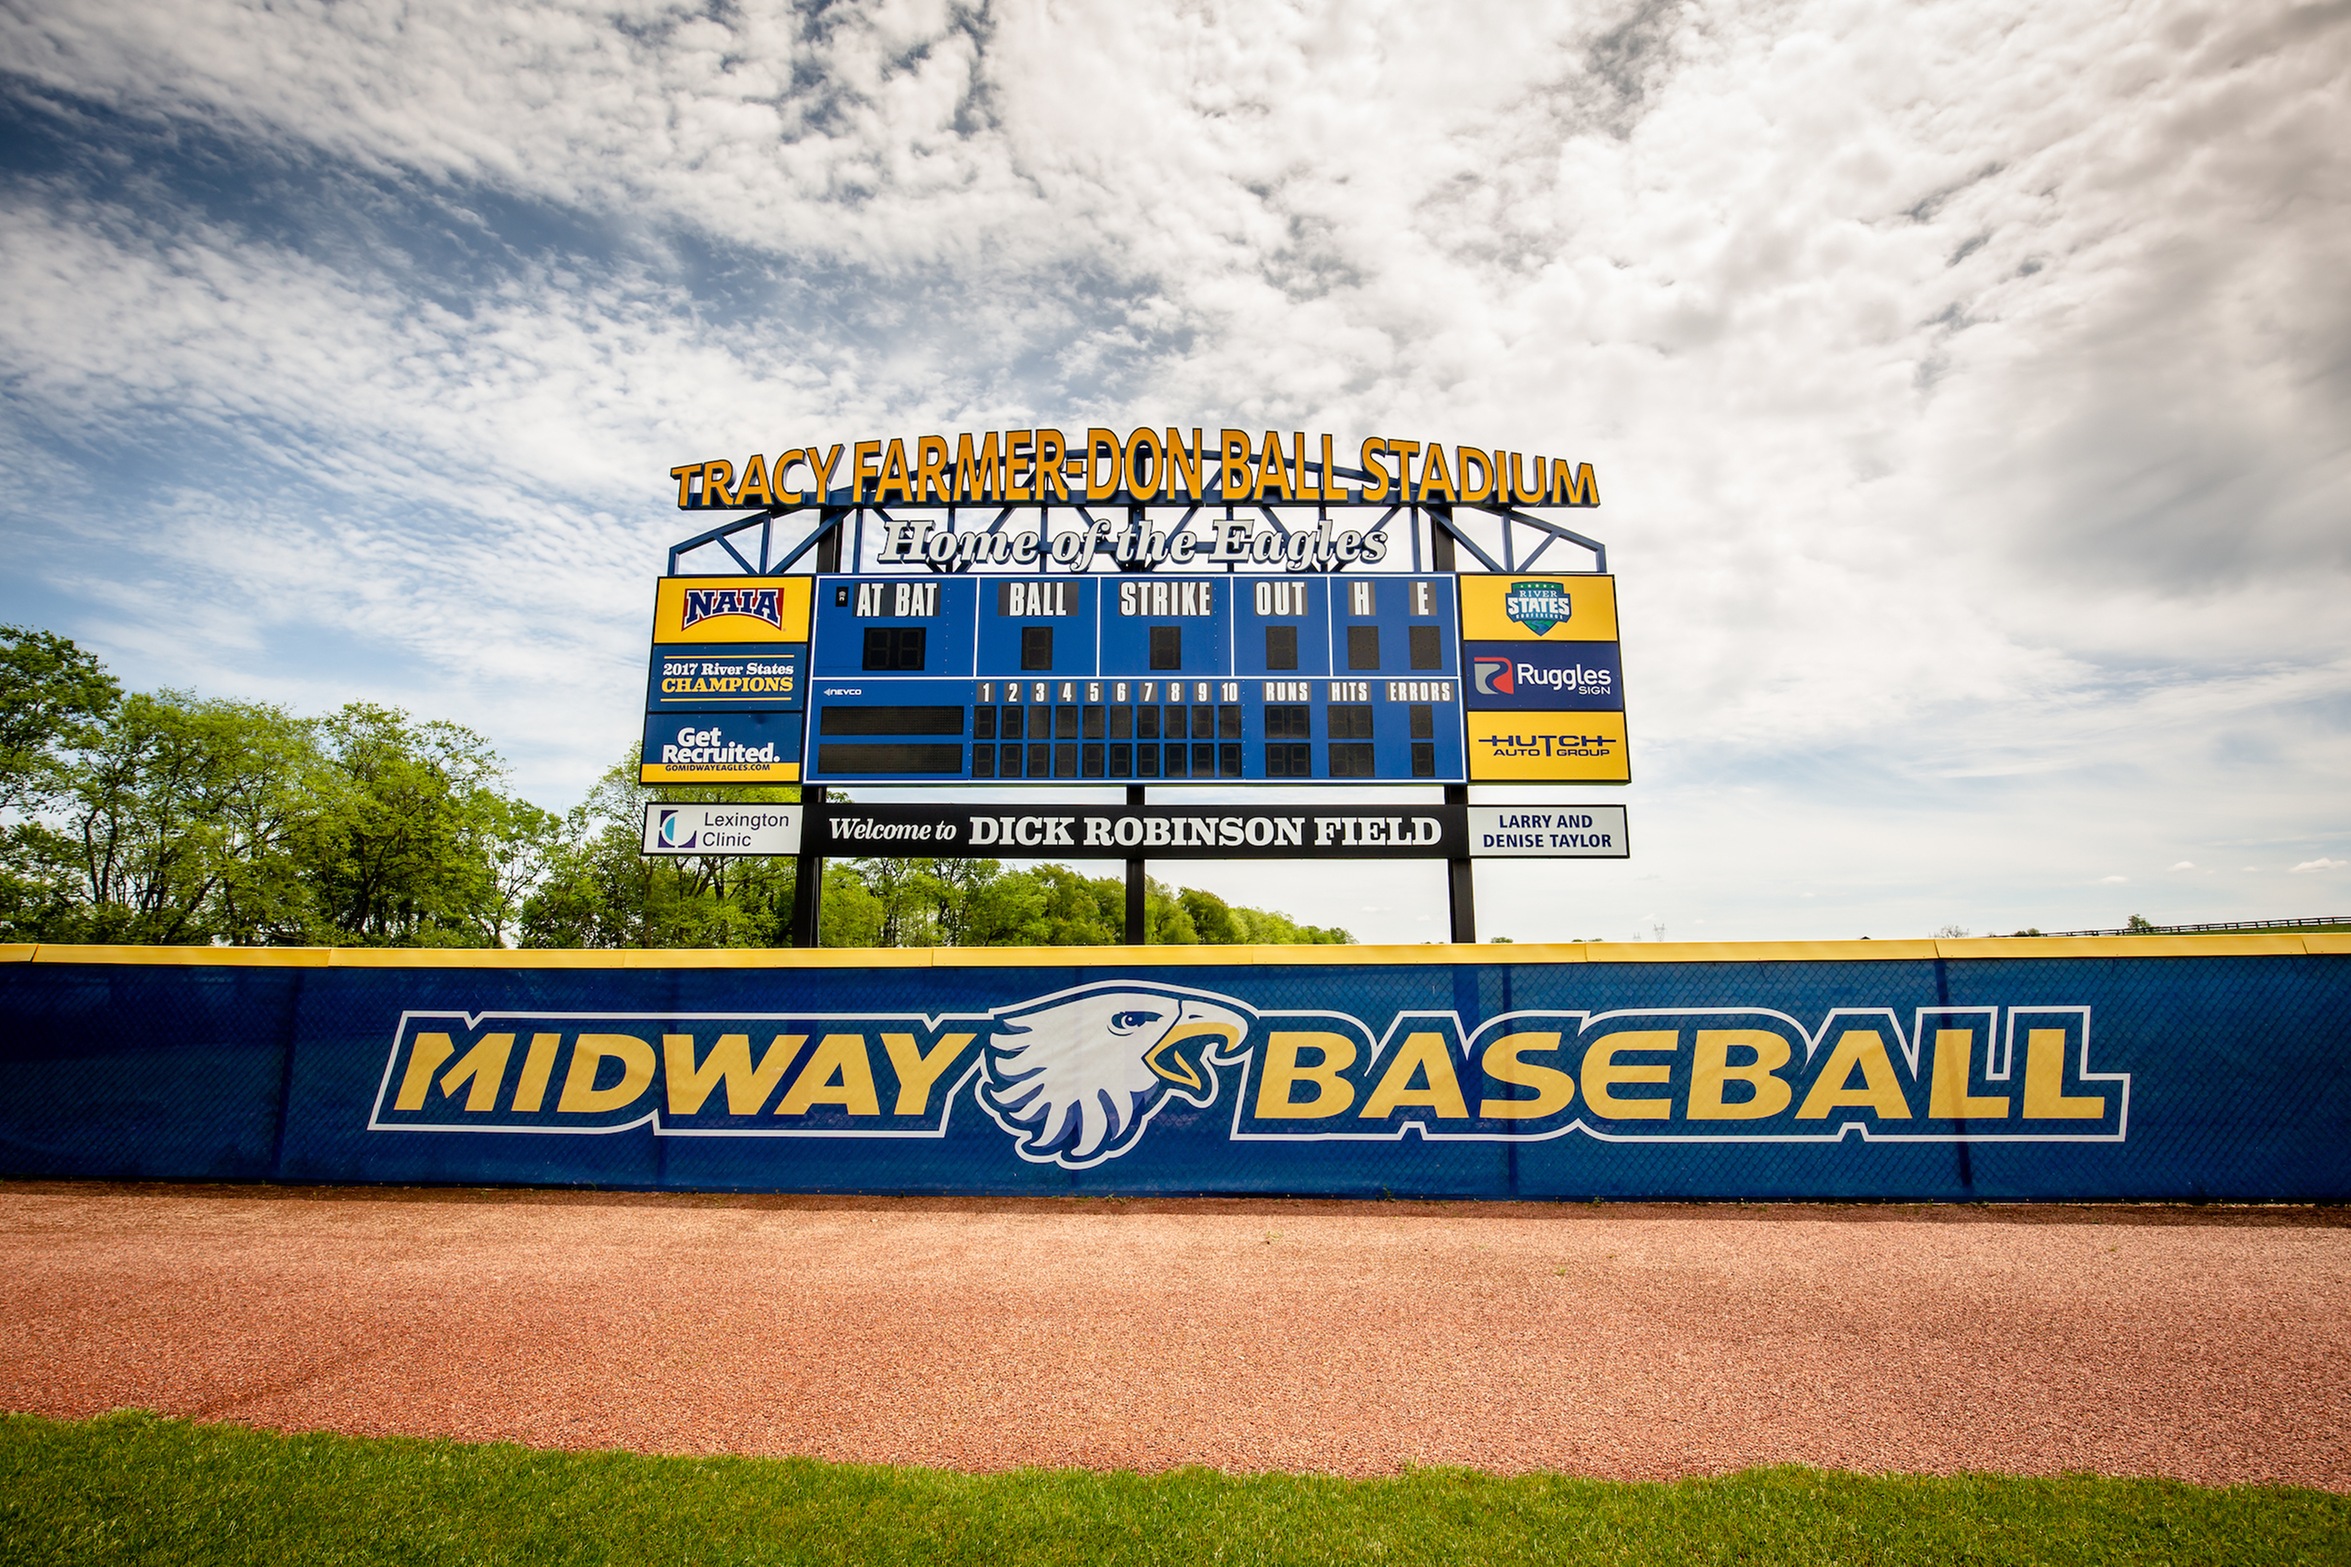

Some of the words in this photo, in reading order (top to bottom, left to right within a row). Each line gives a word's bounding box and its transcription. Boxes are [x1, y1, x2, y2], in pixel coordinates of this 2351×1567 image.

[671, 444, 845, 508] TRACY
[853, 427, 1203, 502] FARMER-DON
[1221, 429, 1348, 501] BALL
[1361, 436, 1601, 506] STADIUM
[878, 520, 1039, 564] Home
[1052, 519, 1111, 573] of
[1116, 519, 1197, 564] the
[1208, 519, 1388, 572] Eagles
[856, 583, 884, 617] AT
[895, 583, 937, 617] BAT
[1009, 582, 1067, 616] BALL
[1120, 581, 1211, 616] STRIKE
[1256, 581, 1305, 616] OUT
[1354, 582, 1370, 616] H
[1417, 582, 1429, 616] E
[1519, 590, 1558, 598] RIVER
[682, 589, 782, 630] NAIA
[1507, 597, 1570, 616] STATES
[662, 663, 698, 676] 2017
[701, 662, 743, 676] River
[746, 662, 794, 675] States
[1517, 663, 1611, 690] Ruggles
[661, 676, 793, 693] CHAMPIONS
[983, 683, 990, 702] 1
[1008, 683, 1018, 702] 2
[1035, 683, 1045, 702] 3
[1062, 683, 1072, 702] 4
[1090, 683, 1099, 702] 5
[1116, 682, 1126, 702] 6
[1144, 682, 1153, 702] 7
[1171, 682, 1180, 702] 8
[1198, 682, 1207, 702] 9
[1222, 682, 1238, 702] 10
[1266, 682, 1309, 702] RUNS
[1331, 682, 1368, 702] HITS
[1390, 682, 1450, 702] ERRORS
[1578, 686, 1611, 695] SIGN
[677, 727, 721, 747] Get
[1479, 735, 1616, 757] HUTCH
[662, 741, 781, 763] Recruited.
[1493, 748, 1541, 757] AUTO
[1556, 748, 1610, 757] GROUP
[665, 763, 770, 772] GOMIDWAYEAGLES.COM
[704, 812, 789, 831] Lexington
[828, 818, 932, 840] Welcome
[935, 820, 957, 841] to
[968, 816, 1075, 846] DICK
[1083, 816, 1306, 847] ROBINSON
[1313, 816, 1443, 847] FIELD
[1499, 814, 1552, 829] LARRY
[1556, 814, 1593, 829] AND
[703, 832, 752, 847] Clinic
[1483, 834, 1544, 848] DENISE
[1549, 834, 1612, 848] TAYLOR
[394, 1032, 977, 1117] MIDWAY
[1254, 1027, 2106, 1122] BASEBALL
